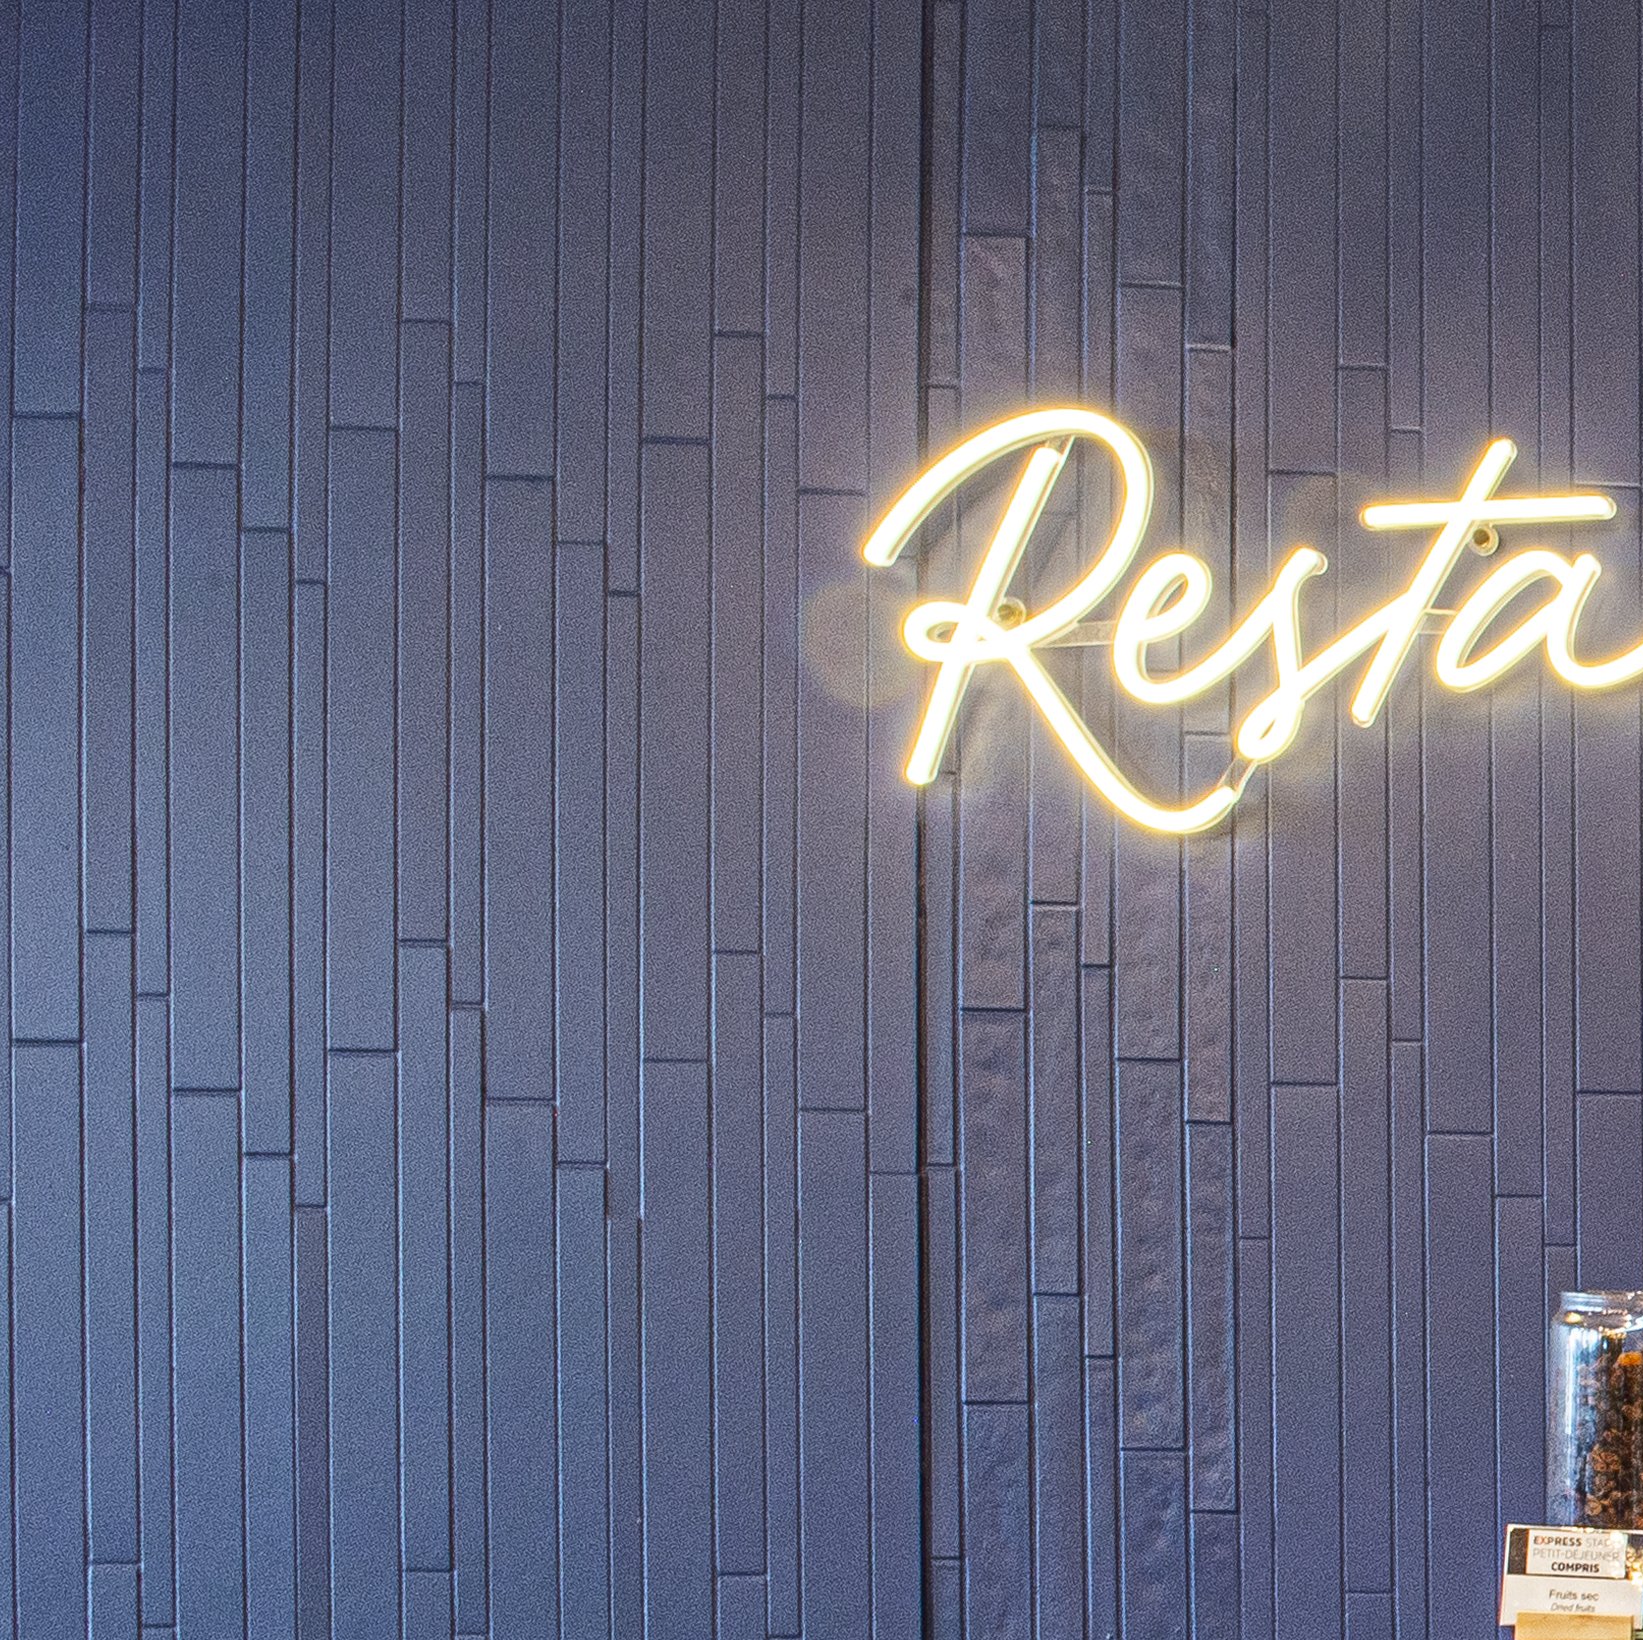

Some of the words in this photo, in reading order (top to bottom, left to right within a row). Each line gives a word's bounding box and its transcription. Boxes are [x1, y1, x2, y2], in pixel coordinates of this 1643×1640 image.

[1533, 1535, 1583, 1547] EXPRESS
[1551, 1561, 1600, 1573] COMPRIS
[1549, 1589, 1577, 1600] Fruits
[1581, 1592, 1600, 1601] sec
